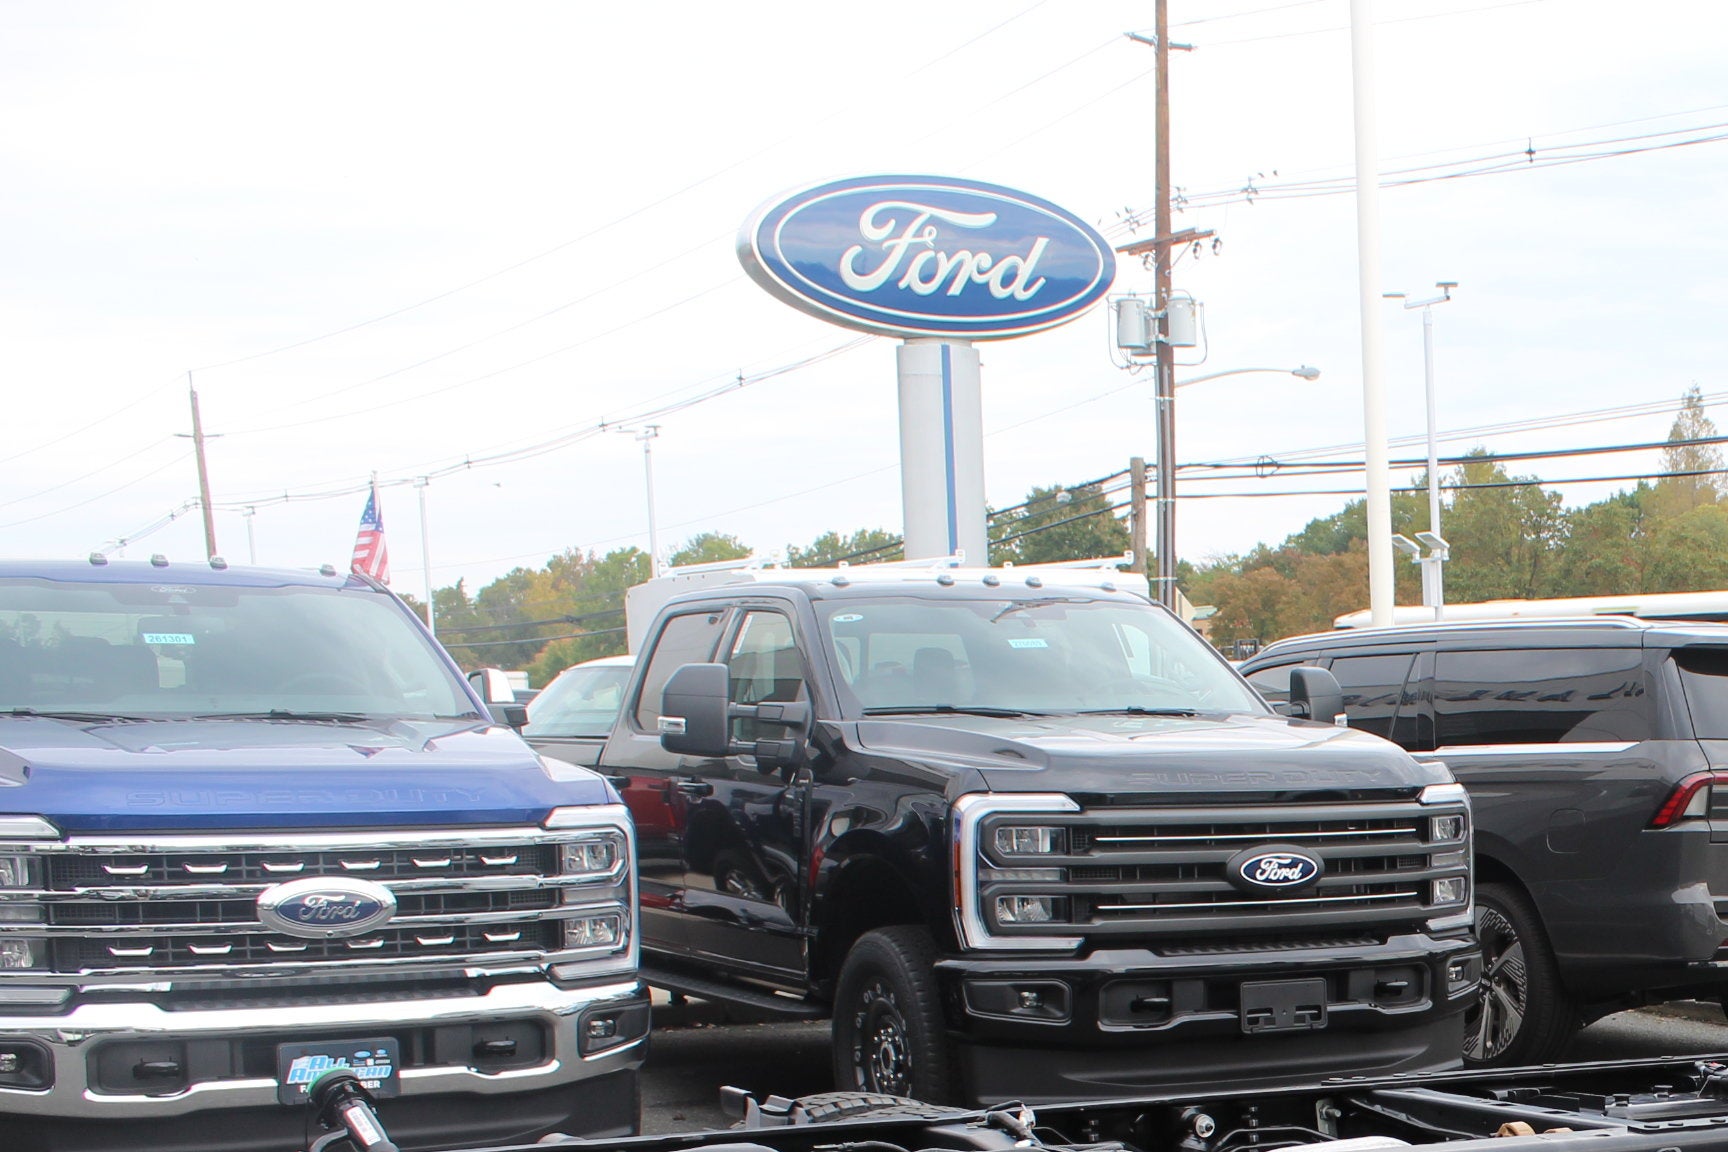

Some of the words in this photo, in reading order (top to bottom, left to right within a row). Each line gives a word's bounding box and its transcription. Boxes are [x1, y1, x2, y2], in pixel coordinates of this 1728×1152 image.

[839, 200, 1050, 301] Ford
[1255, 857, 1303, 880] Ford
[299, 895, 361, 920] Ford
